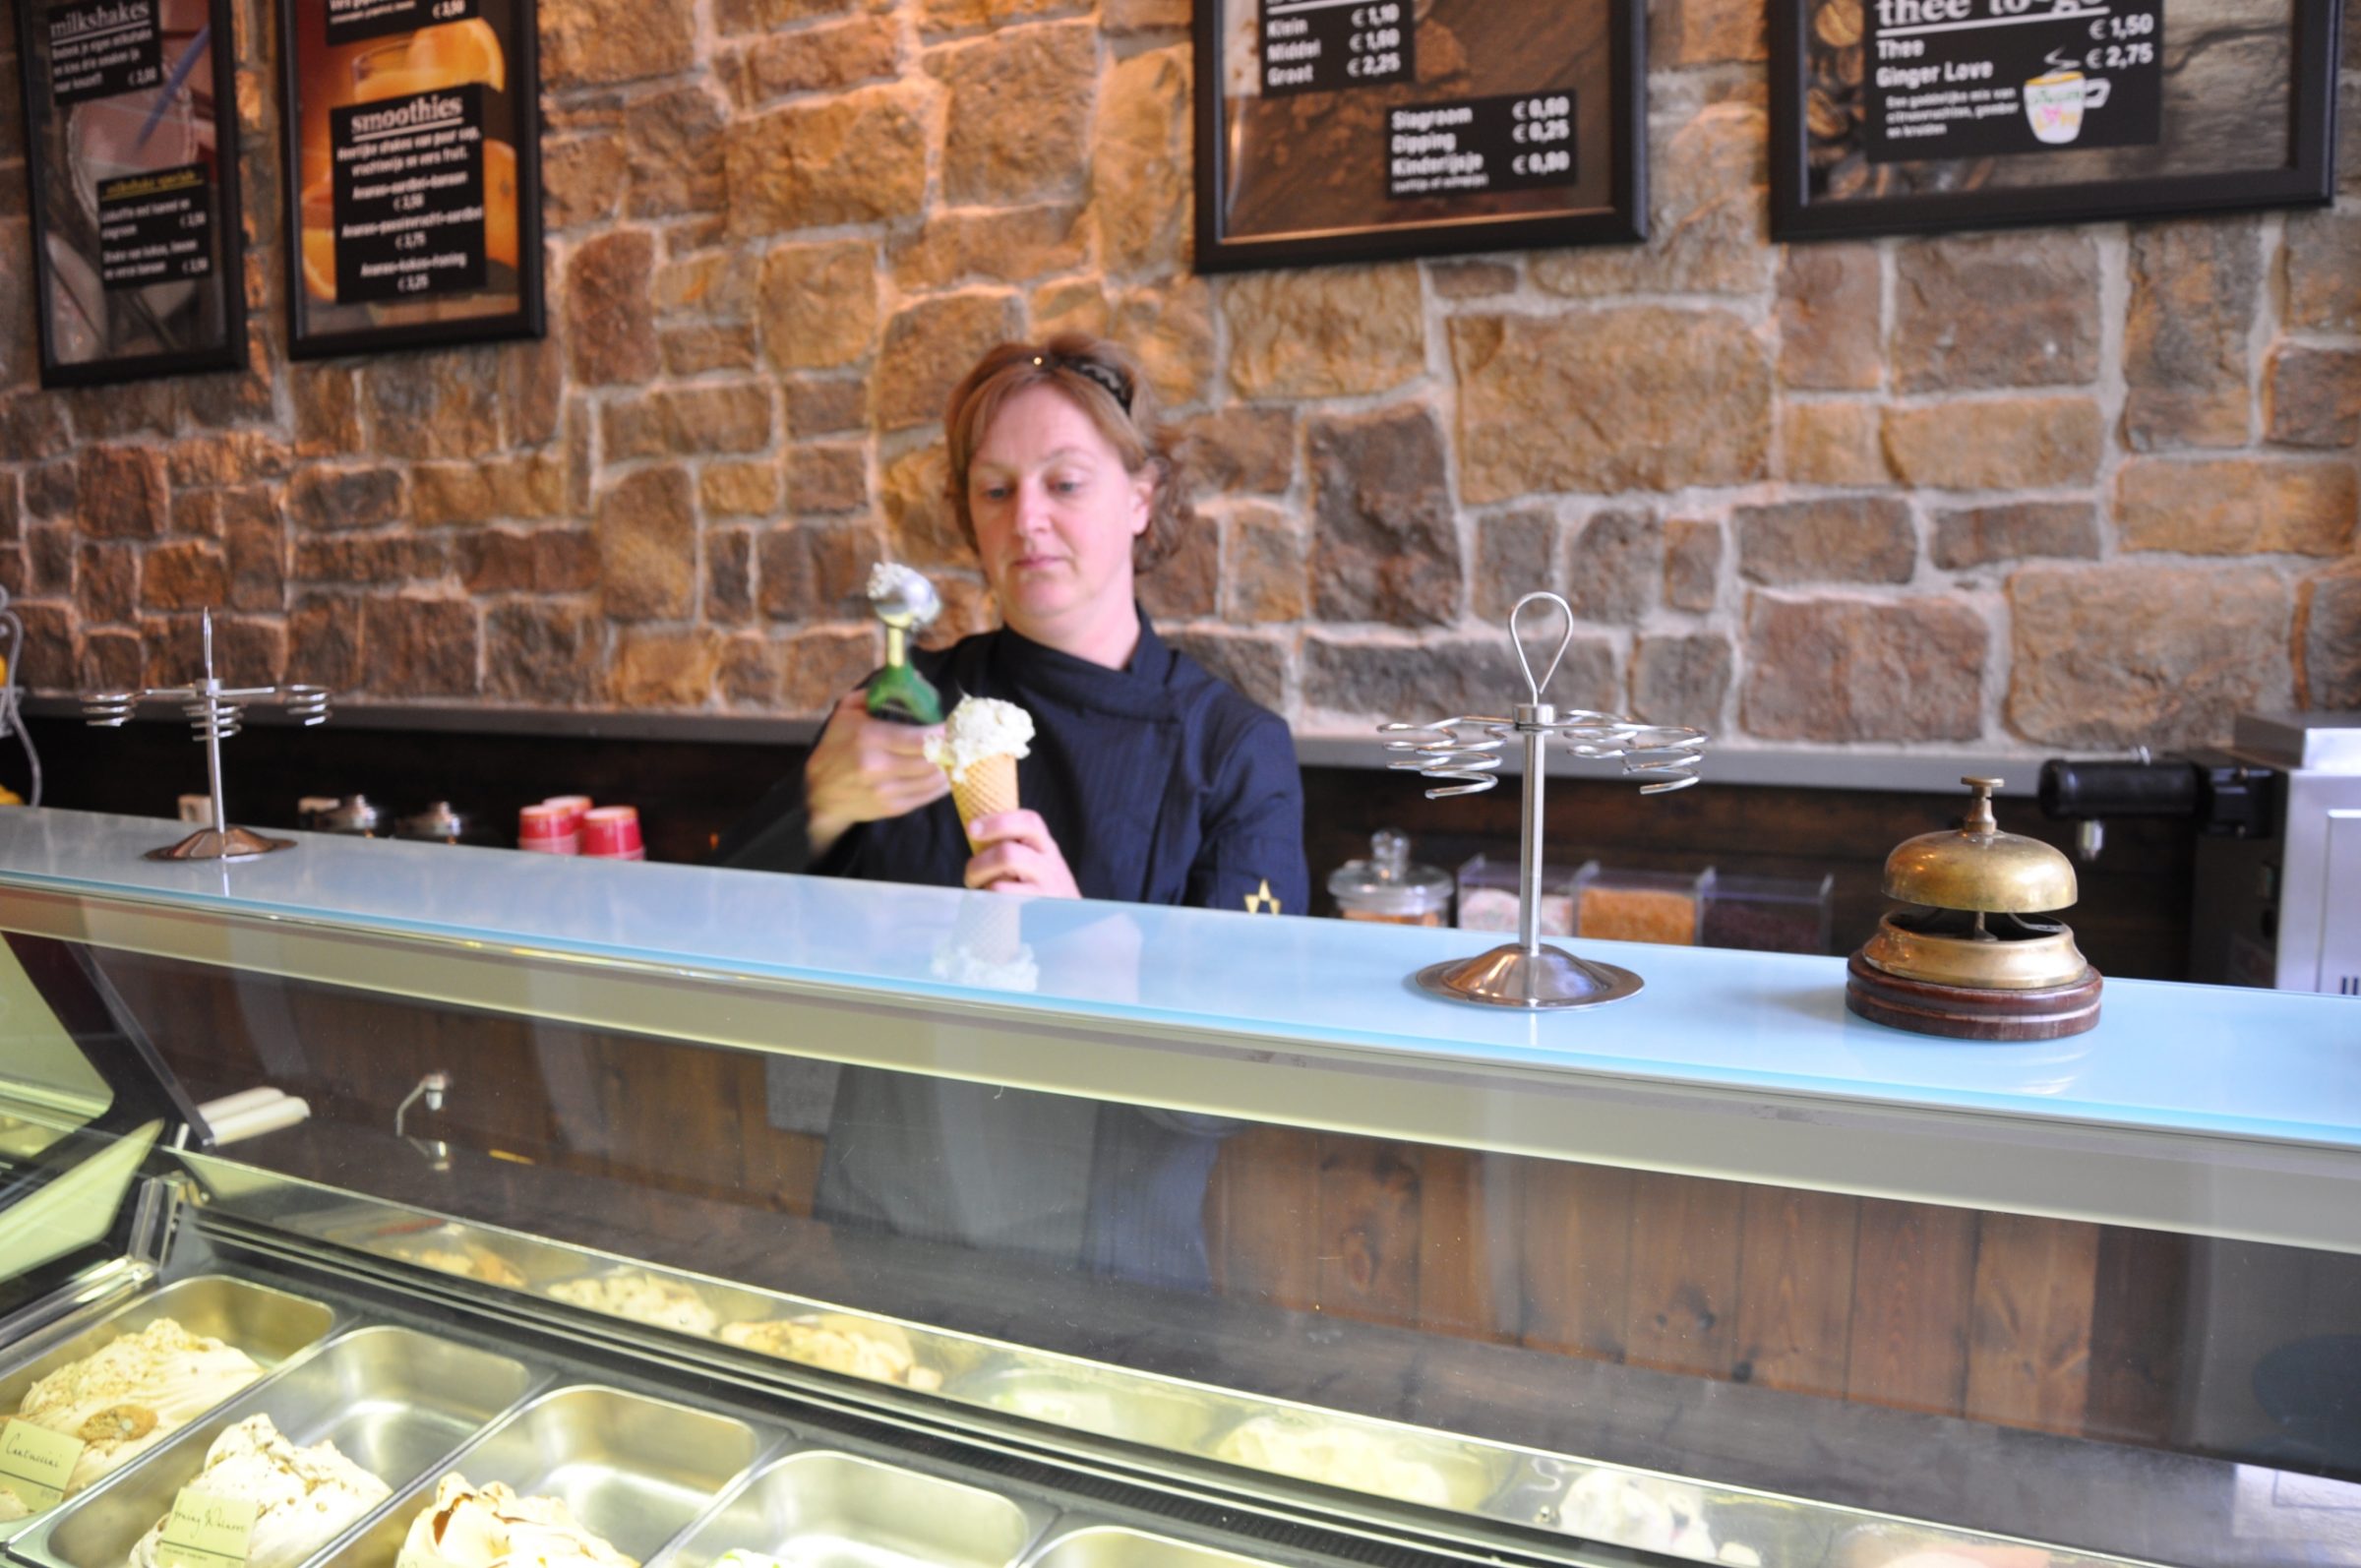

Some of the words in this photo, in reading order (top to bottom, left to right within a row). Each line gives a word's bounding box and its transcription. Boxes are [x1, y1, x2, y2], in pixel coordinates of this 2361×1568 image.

[51, 2, 151, 37] milkshakes
[2109, 14, 2154, 39] 1,50
[1876, 38, 1925, 60] Thee
[2105, 42, 2154, 69] 2,75
[1876, 66, 1941, 89] Ginger
[1943, 61, 1994, 83] Love
[351, 95, 463, 133] smoothies
